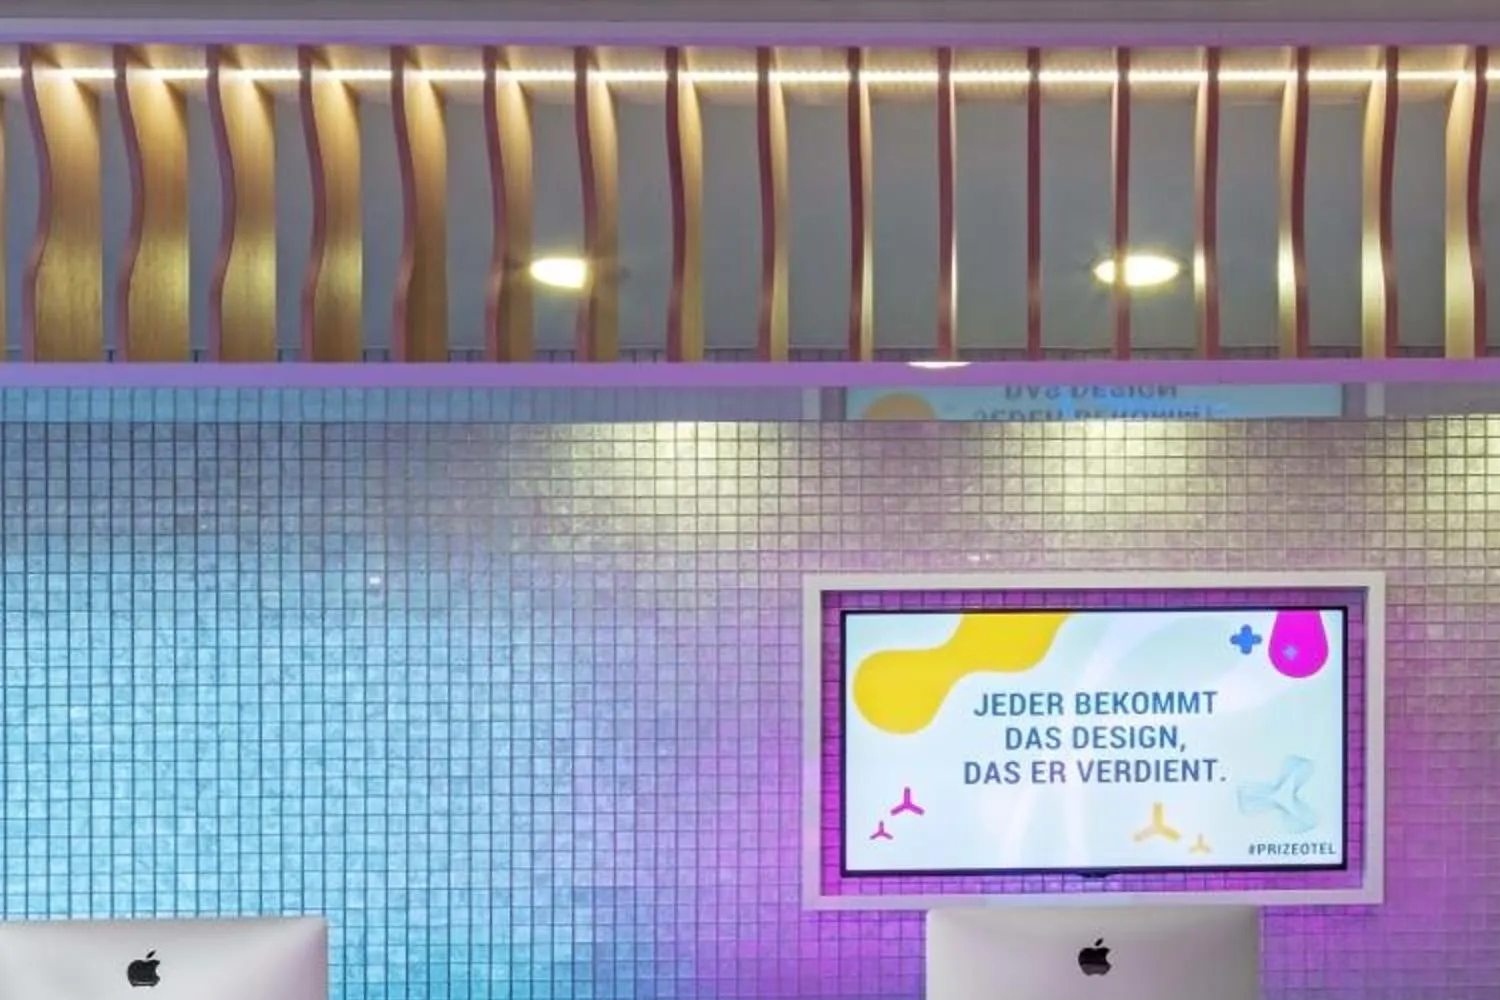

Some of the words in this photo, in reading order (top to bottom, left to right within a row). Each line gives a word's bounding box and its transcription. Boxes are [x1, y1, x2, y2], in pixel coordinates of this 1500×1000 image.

[974, 693, 1063, 716] JEDER
[1075, 692, 1217, 715] BEKOMMT
[1005, 727, 1060, 750] DAS
[1072, 726, 1186, 752] DESIGN,
[963, 762, 1020, 784] DAS
[1031, 761, 1066, 783] ER
[1077, 759, 1226, 783] VERDIENT.
[1248, 842, 1336, 856] #PRIZEOTEL
